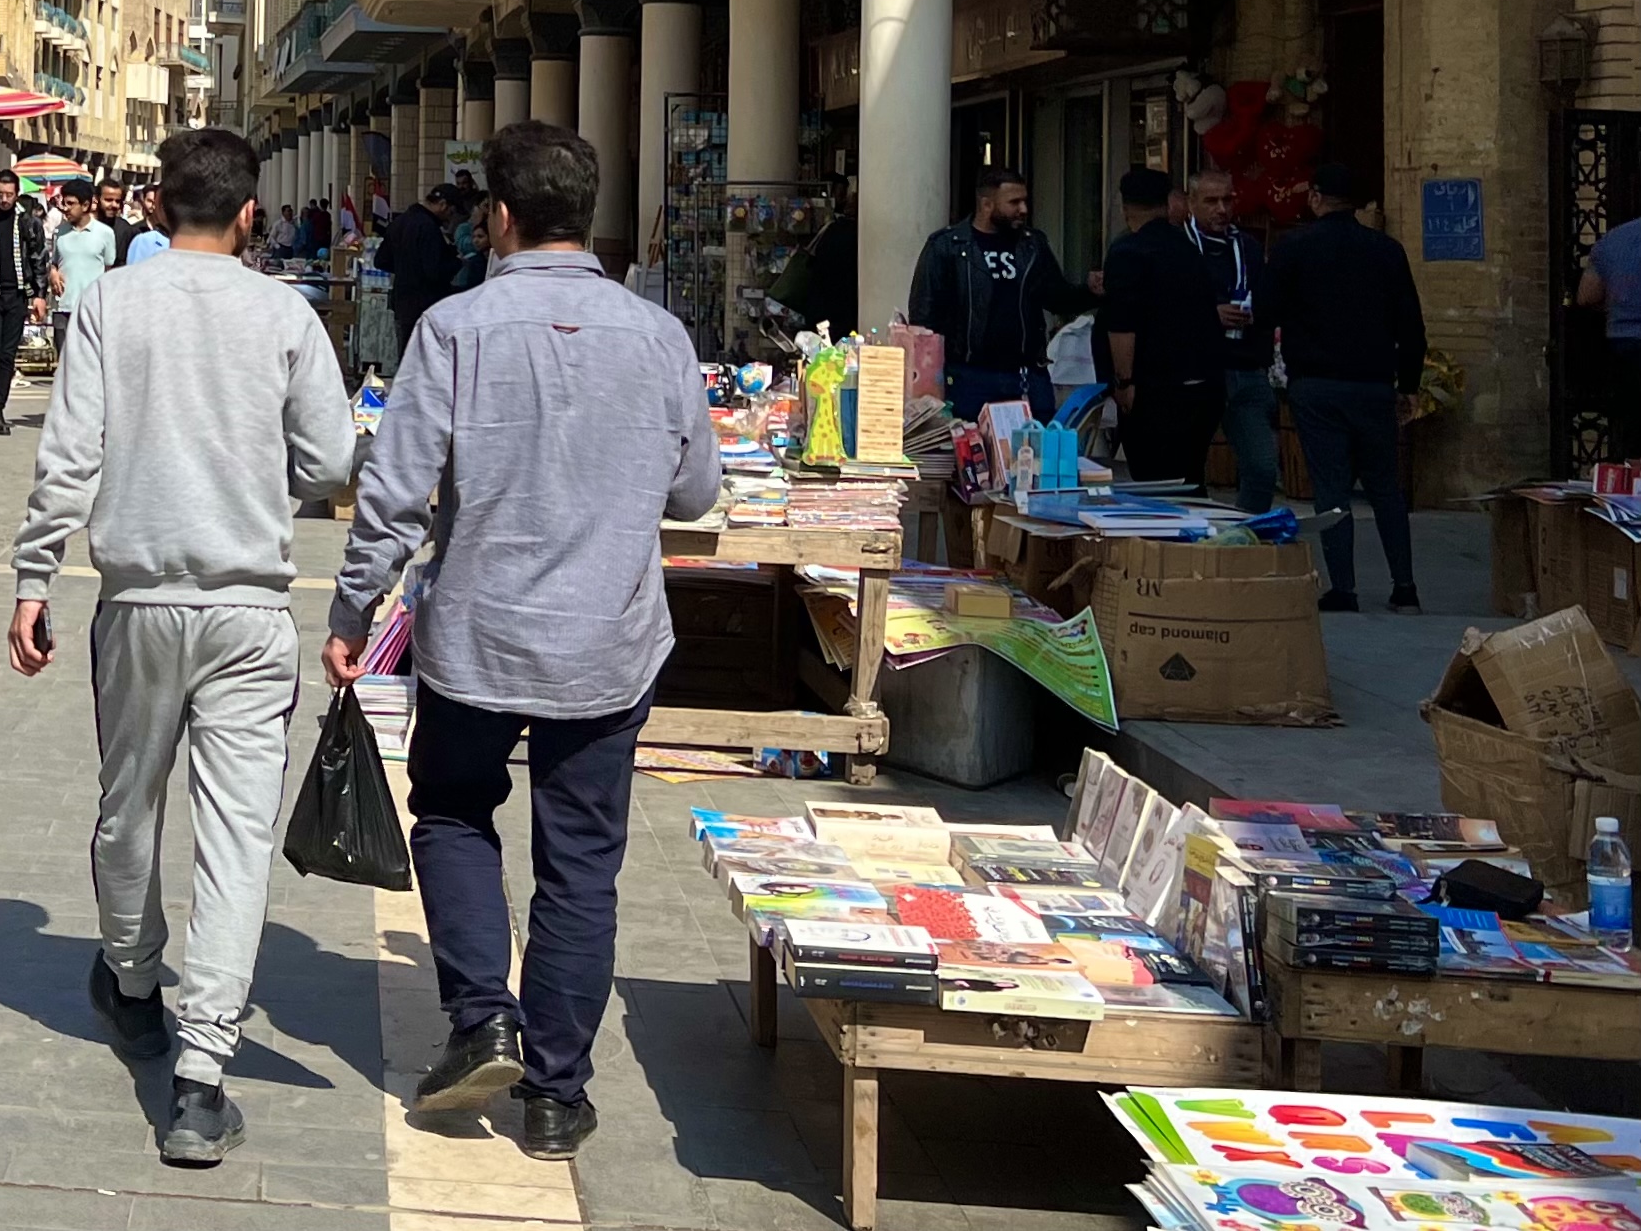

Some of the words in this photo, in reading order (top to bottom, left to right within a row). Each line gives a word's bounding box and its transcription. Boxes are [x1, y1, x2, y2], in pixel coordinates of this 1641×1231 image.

[1129, 622, 1156, 636] cap
[1160, 626, 1230, 644] Diamond
[1173, 1098, 1257, 1119] V
[1267, 1104, 1347, 1127] Q
[1360, 1110, 1436, 1129] L
[1451, 1117, 1538, 1142] F
[1287, 1130, 1373, 1154] R
[1211, 1144, 1304, 1169] X
[1311, 1156, 1391, 1175] S
